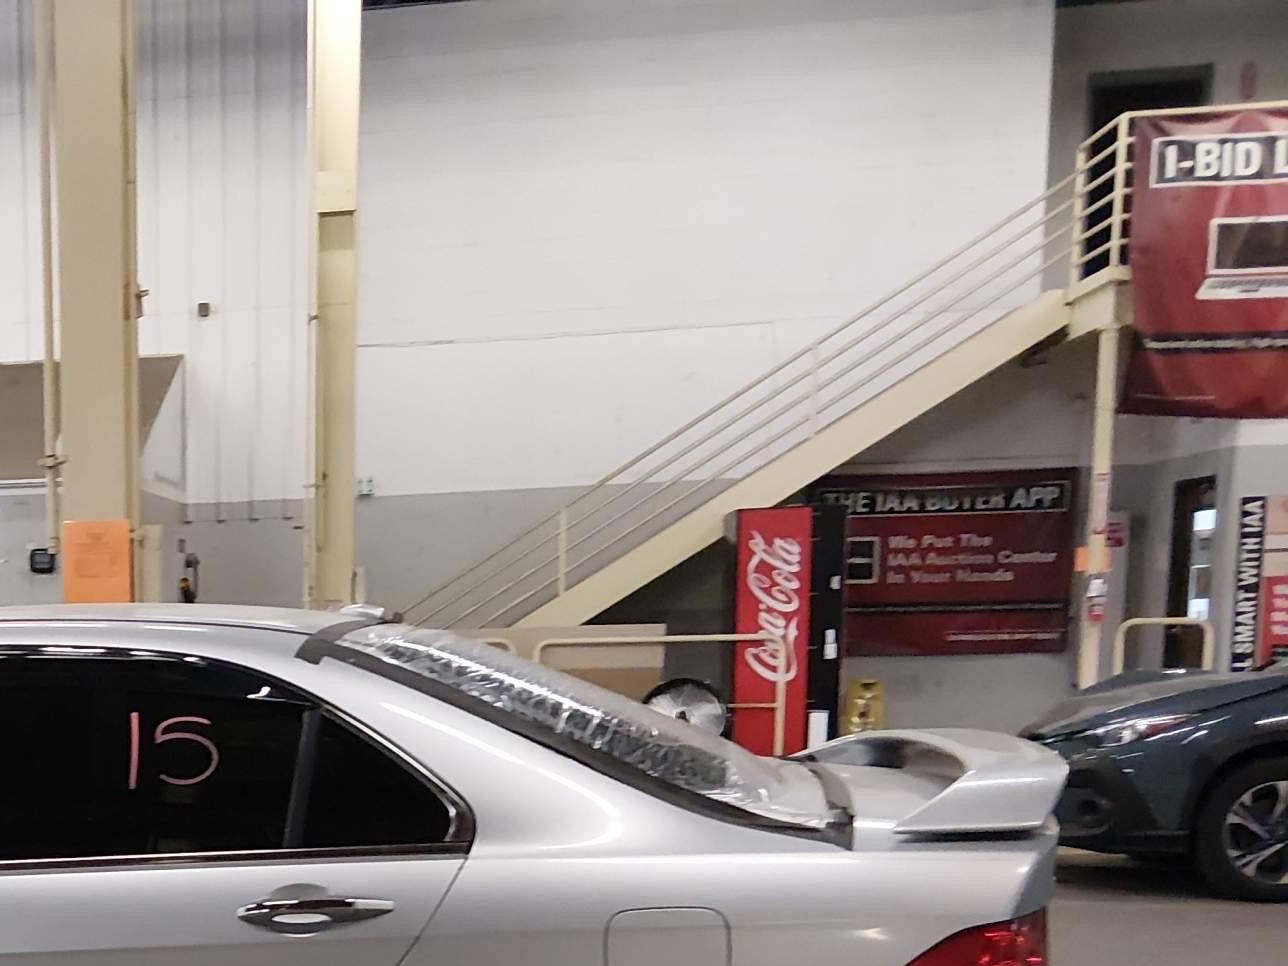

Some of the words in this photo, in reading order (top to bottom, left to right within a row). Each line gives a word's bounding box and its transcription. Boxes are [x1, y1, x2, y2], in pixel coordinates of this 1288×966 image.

[1164, 140, 1262, 179] I-BID
[874, 490, 919, 512] IAA
[1009, 486, 1062, 509] APP
[1241, 500, 1265, 532] IAA
[886, 552, 923, 567] IAA
[1237, 537, 1262, 587] WITH
[1233, 589, 1258, 653] SMART
[128, 711, 220, 790] 15
